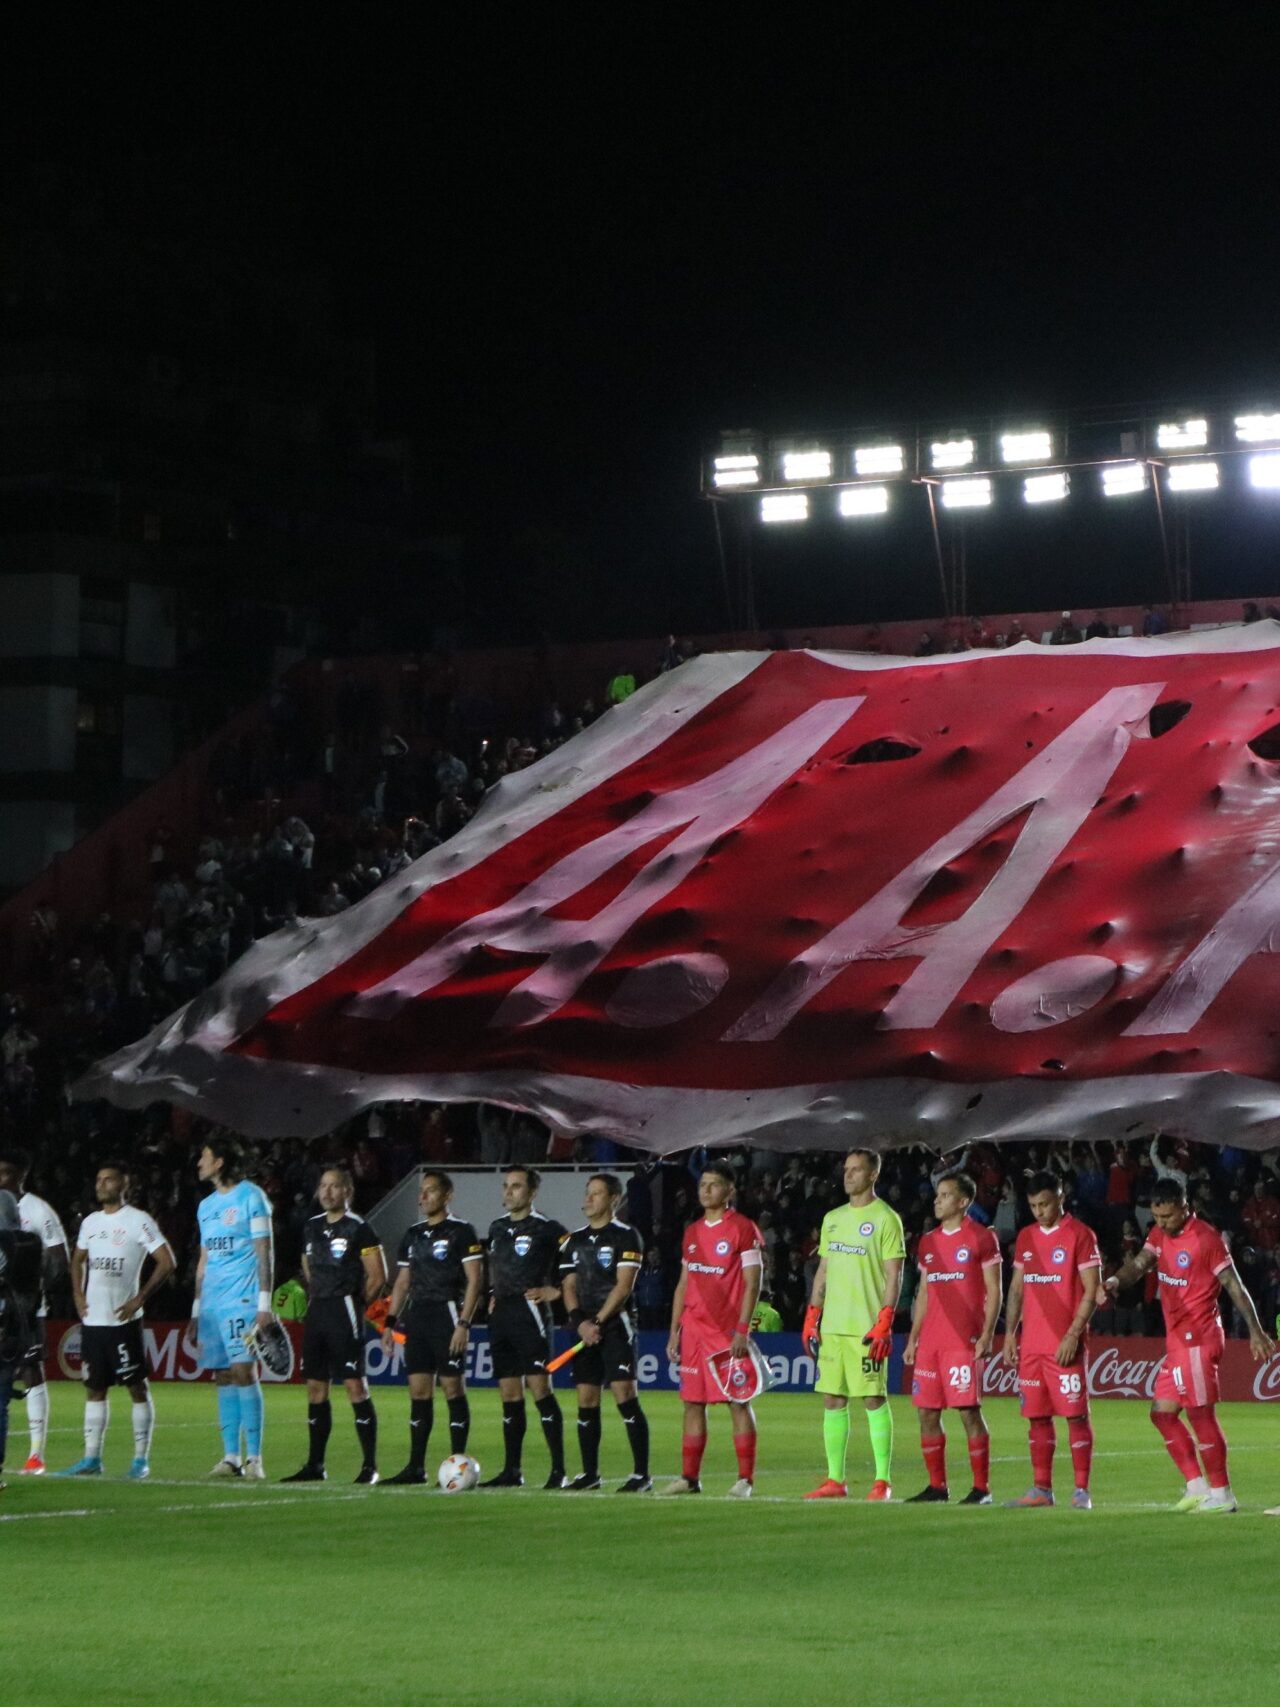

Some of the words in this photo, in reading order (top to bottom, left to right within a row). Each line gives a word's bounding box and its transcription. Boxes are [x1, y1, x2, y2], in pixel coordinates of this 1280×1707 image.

[117, 1343, 130, 1362] 5
[949, 1365, 971, 1386] 29
[1059, 1373, 1081, 1394] 36
